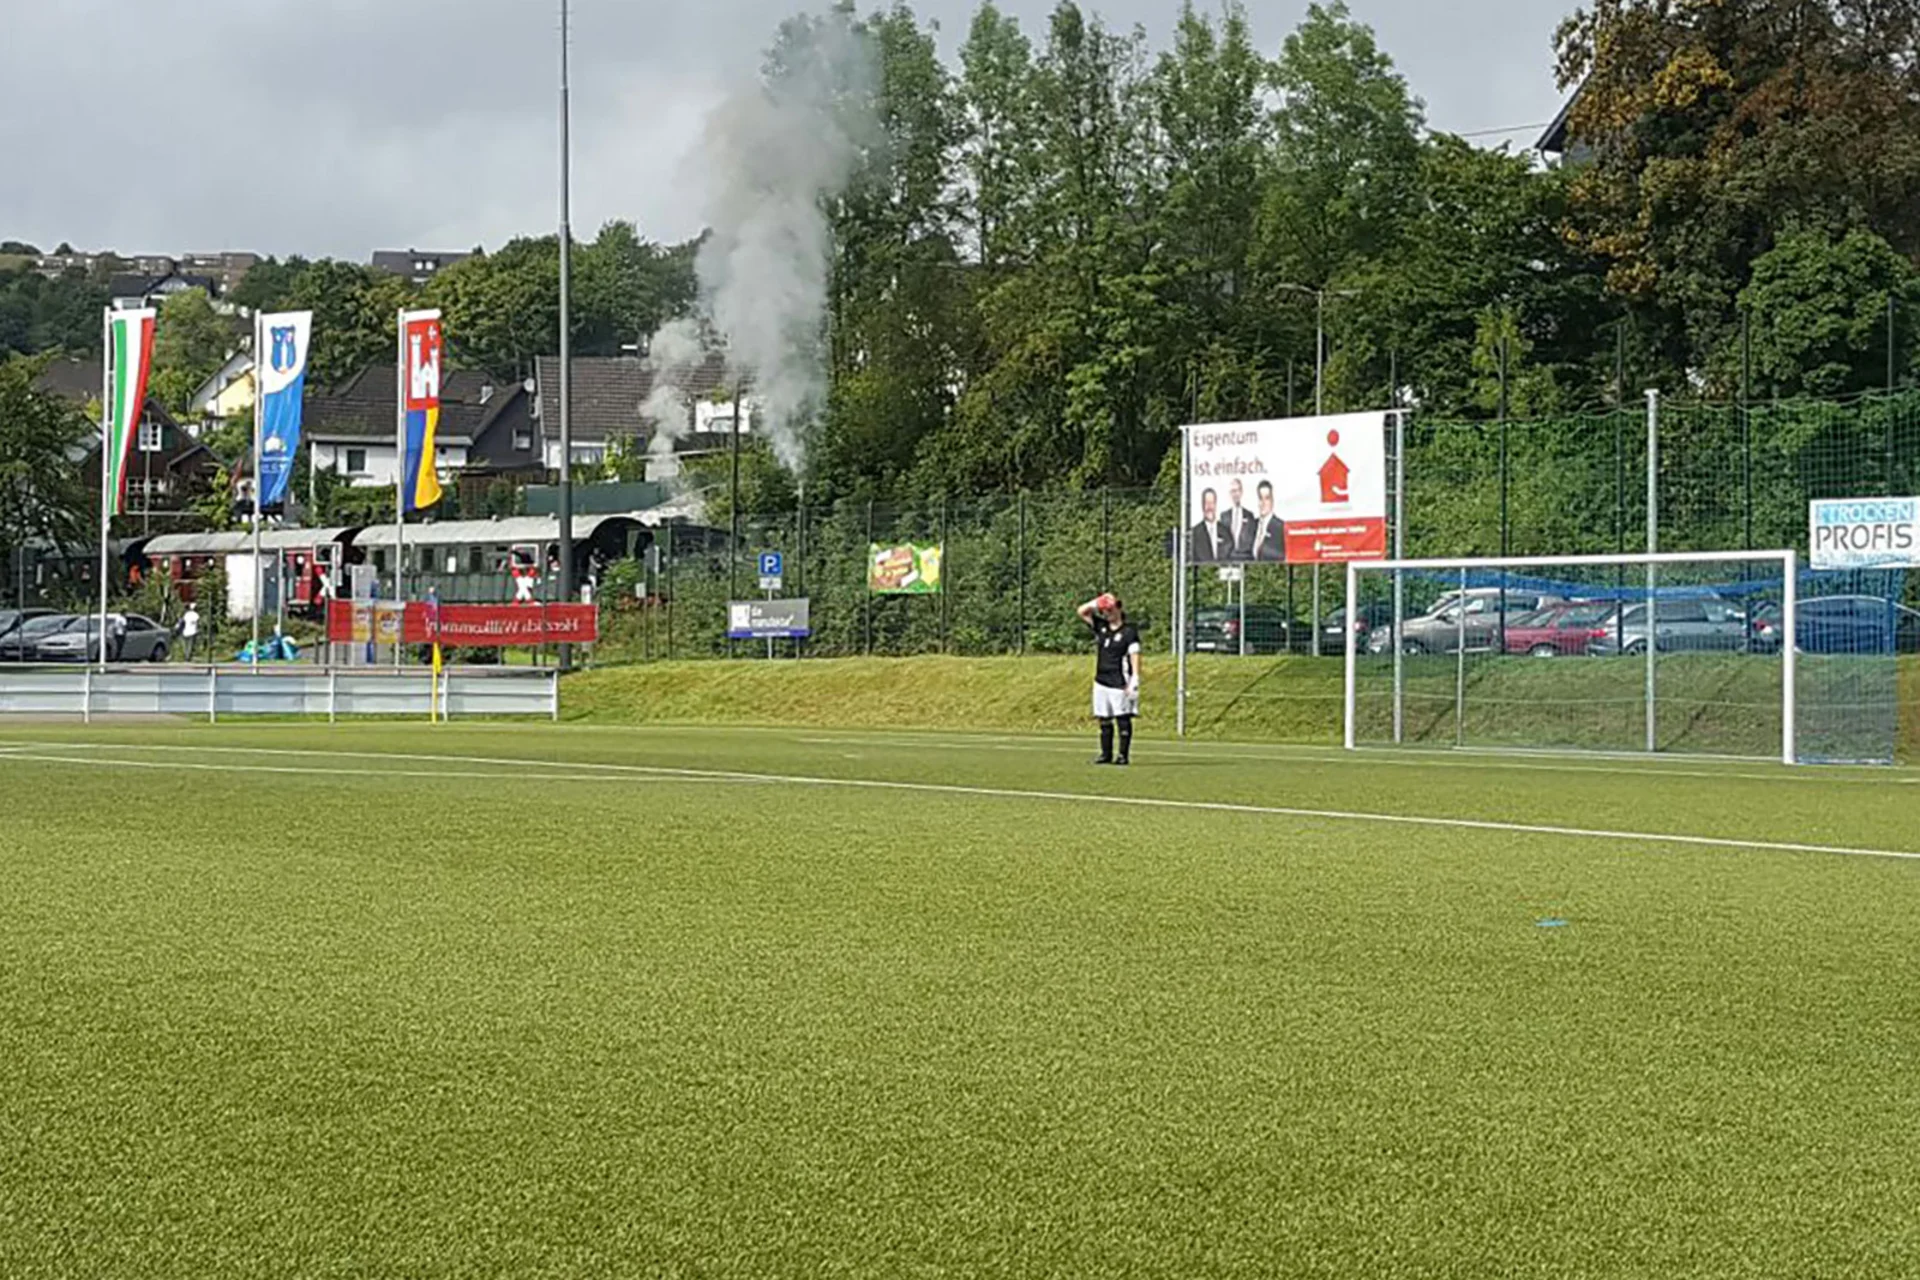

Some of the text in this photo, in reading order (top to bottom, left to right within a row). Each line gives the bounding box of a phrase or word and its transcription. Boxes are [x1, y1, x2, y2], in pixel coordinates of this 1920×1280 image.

[1193, 430, 1259, 452] Eigentum
[1194, 455, 1269, 476] ist einfach.
[1815, 523, 1913, 550] PROFIS
[764, 555, 778, 573] P
